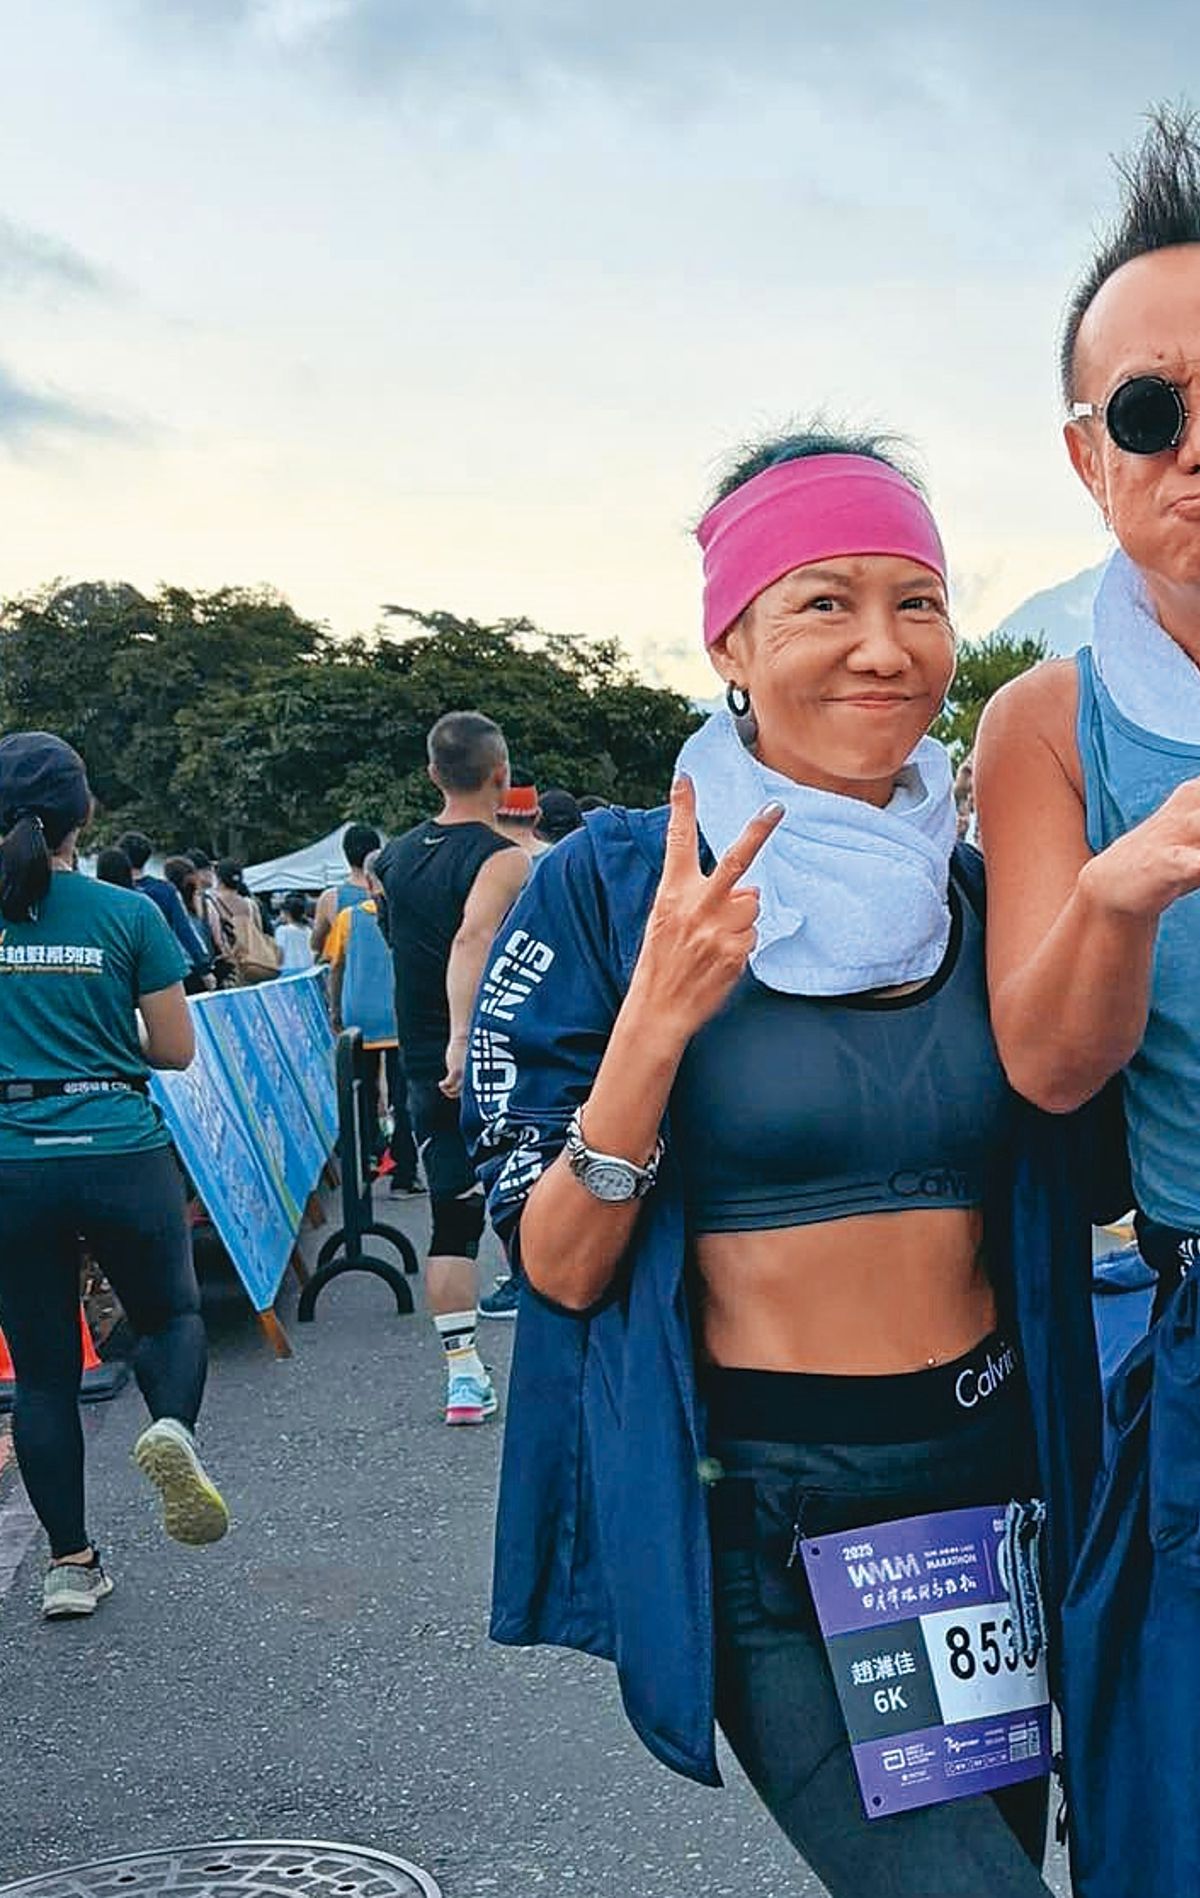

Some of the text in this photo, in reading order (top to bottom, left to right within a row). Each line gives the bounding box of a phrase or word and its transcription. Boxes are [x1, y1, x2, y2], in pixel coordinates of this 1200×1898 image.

[480, 929, 556, 1022] SUN
[842, 1543, 874, 1561] 2025
[873, 1685, 909, 1715] 6K
